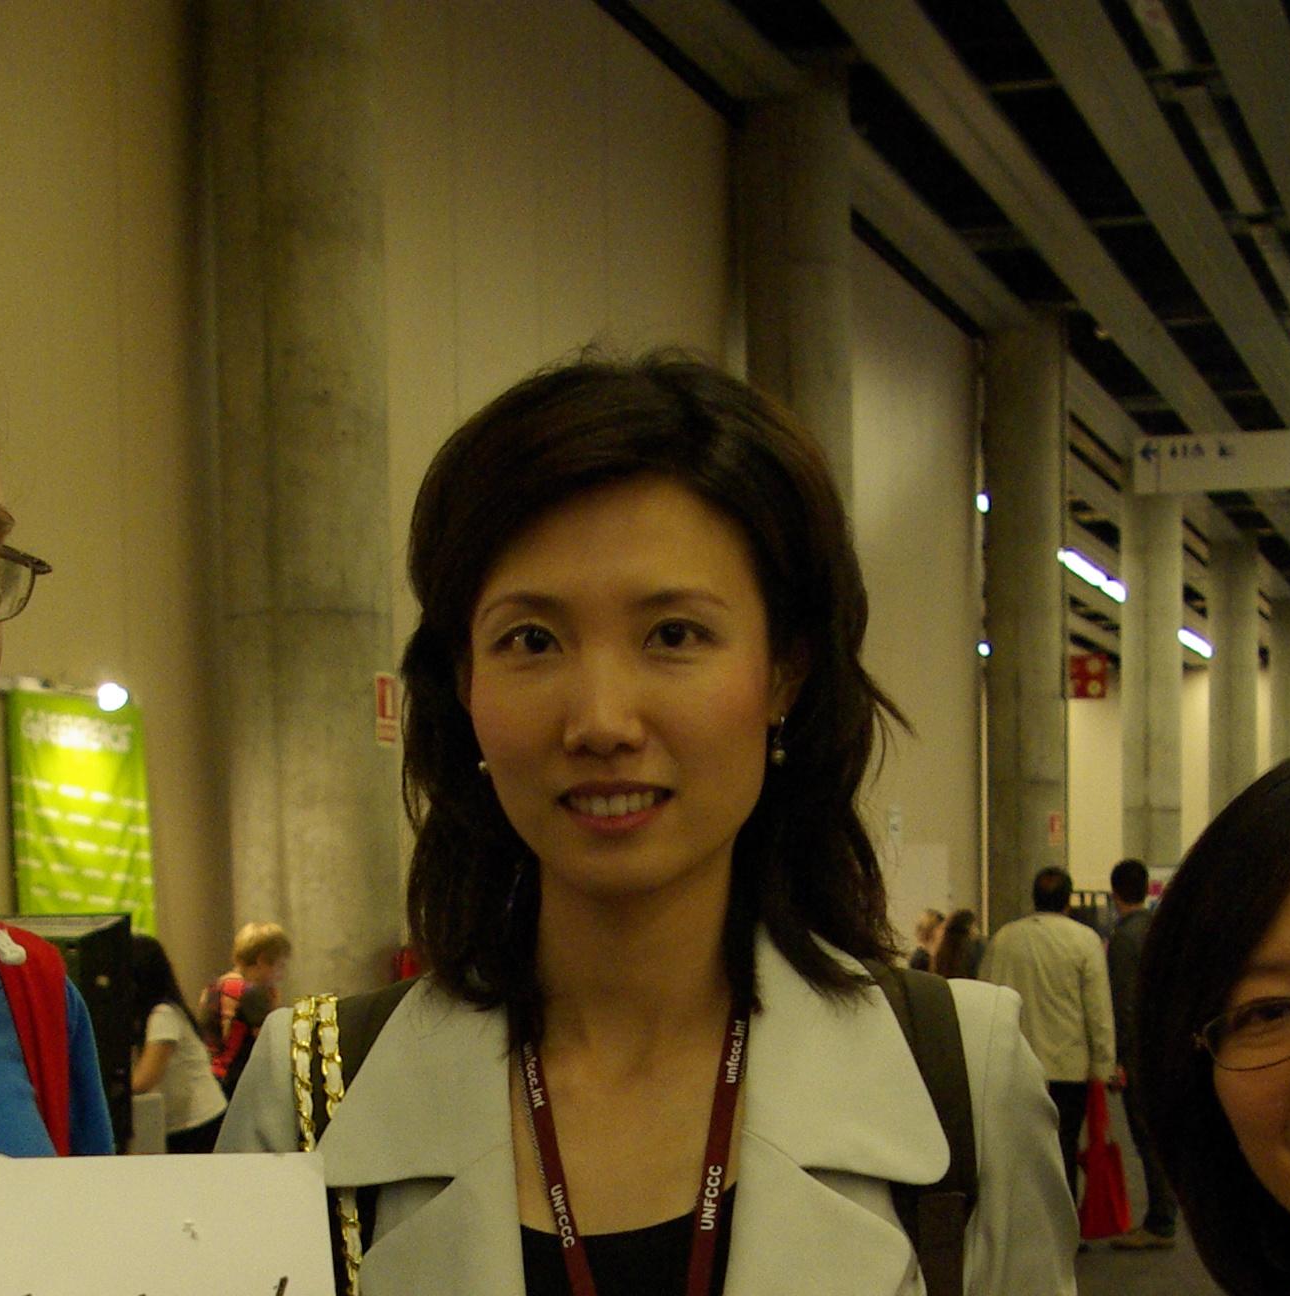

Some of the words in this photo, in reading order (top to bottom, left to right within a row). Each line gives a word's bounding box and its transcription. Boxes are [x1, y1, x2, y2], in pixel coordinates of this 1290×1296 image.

[725, 1019, 747, 1084] unfccc.int
[550, 1183, 576, 1248] UNFCCC
[700, 1164, 723, 1231] UNFCCC
